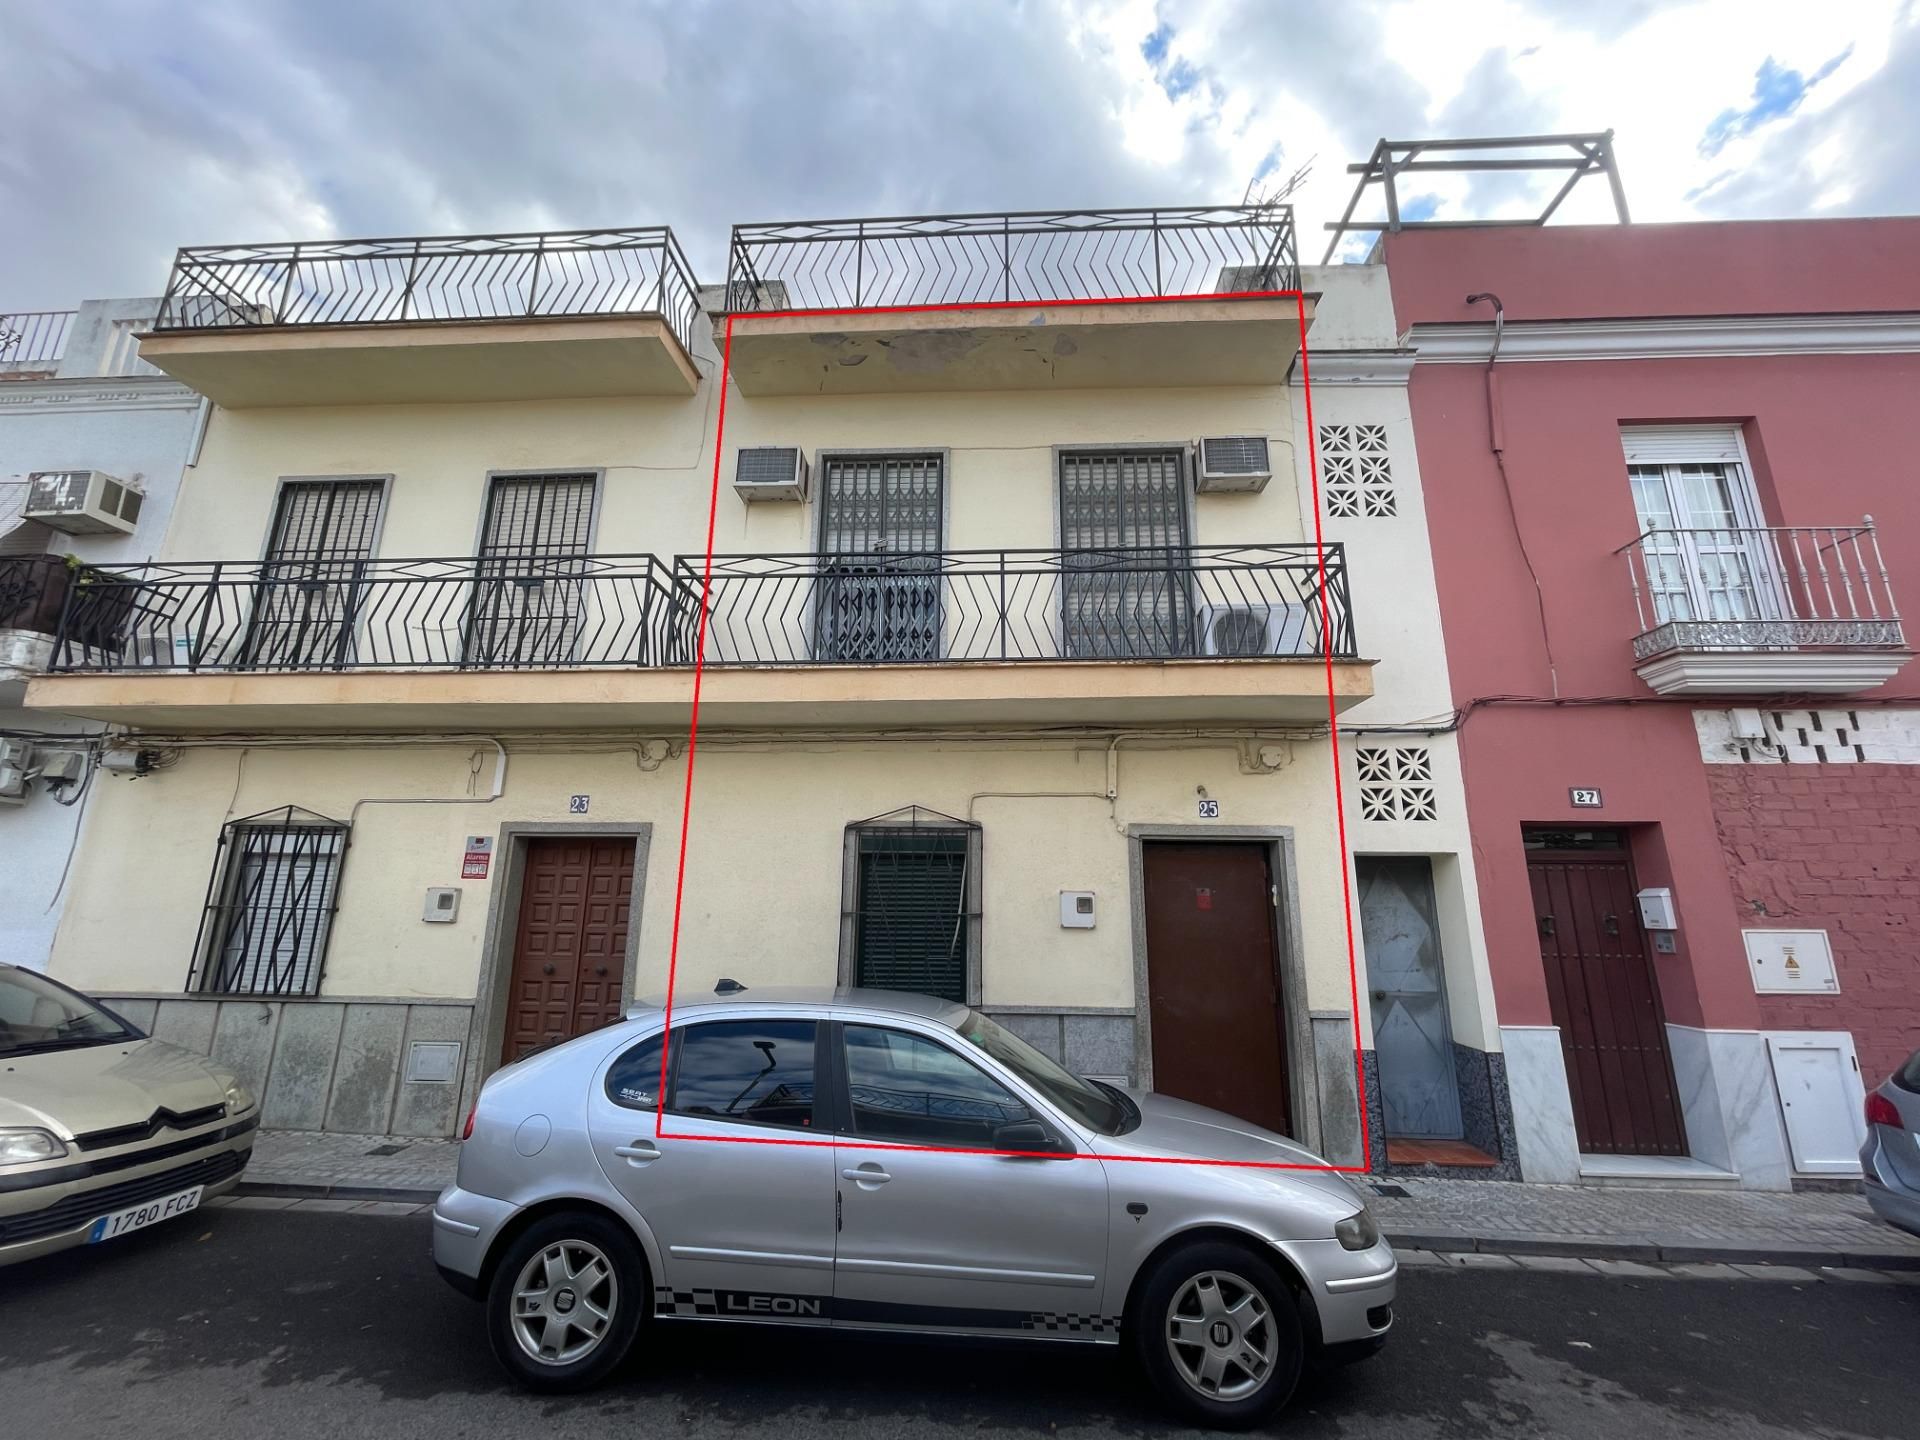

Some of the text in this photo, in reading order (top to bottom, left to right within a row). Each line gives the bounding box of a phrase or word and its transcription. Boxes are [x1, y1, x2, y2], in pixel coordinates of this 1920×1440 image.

[571, 797, 589, 812] 23
[1576, 791, 1594, 803] 27
[1199, 801, 1217, 816] 25
[112, 1190, 199, 1234] 1780 FCZ
[727, 1294, 820, 1315] LEON
